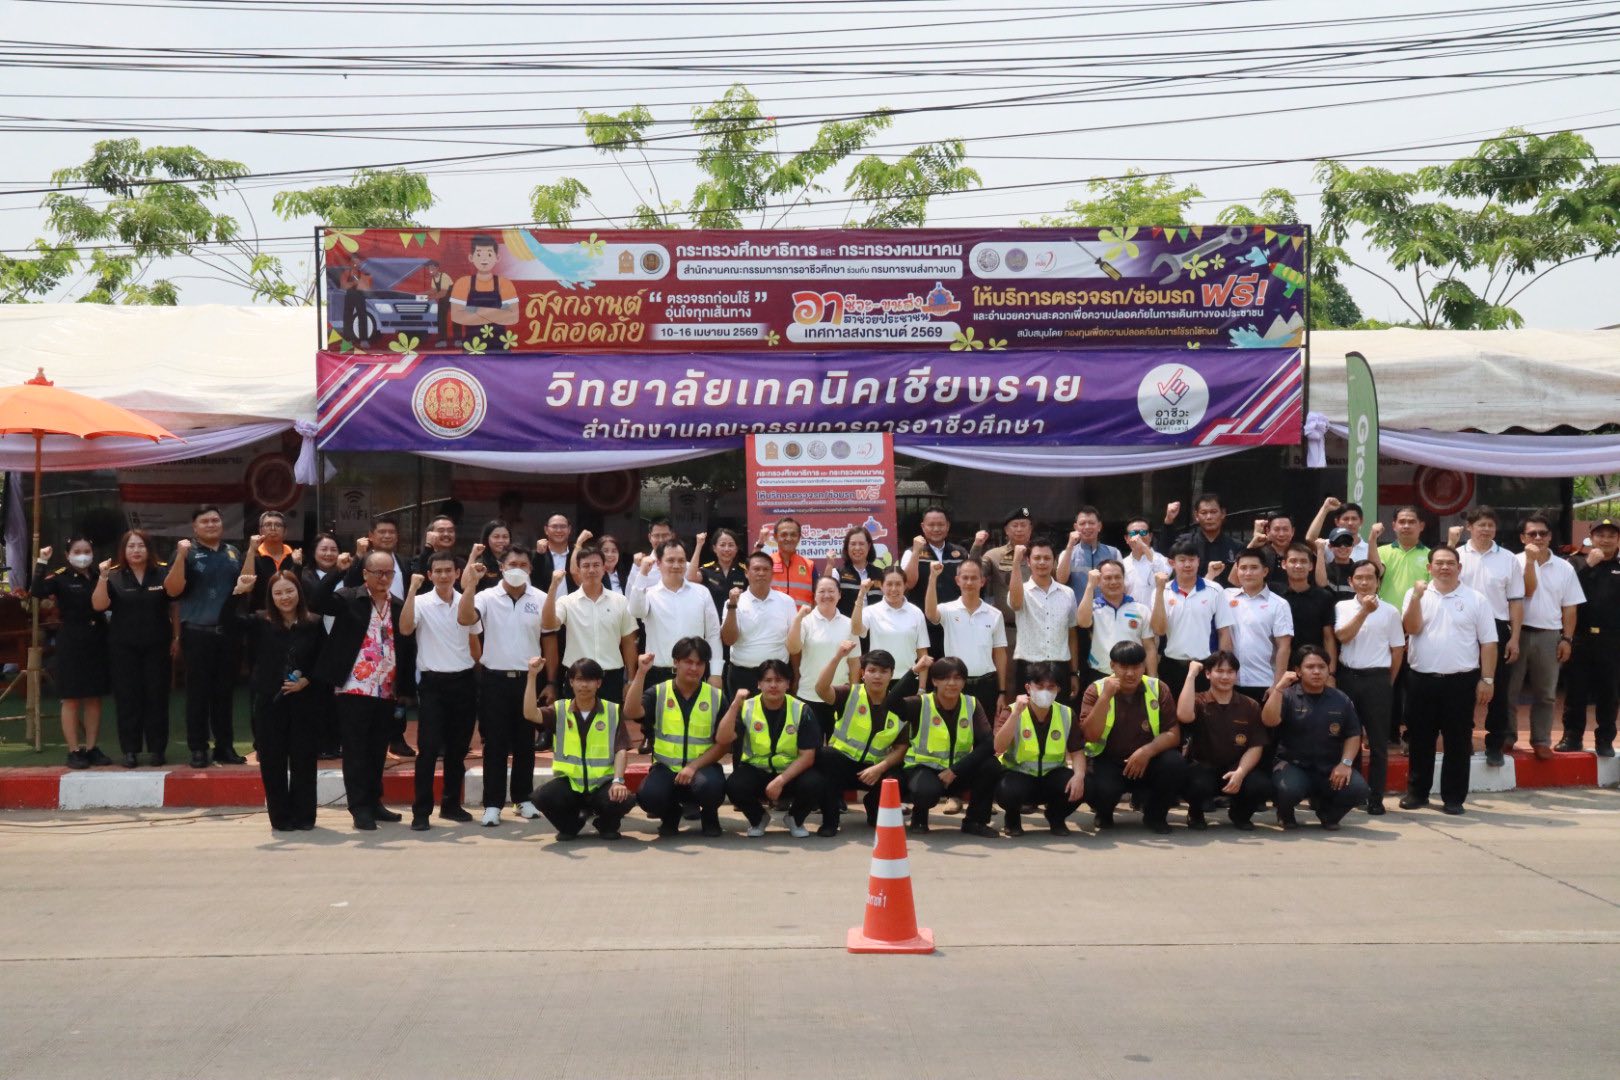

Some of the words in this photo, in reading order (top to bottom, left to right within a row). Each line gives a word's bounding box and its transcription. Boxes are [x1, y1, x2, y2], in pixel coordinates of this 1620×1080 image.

[676, 242, 818, 258] กระทรวงศึกษาธิการ
[820, 247, 836, 257] และ
[838, 244, 963, 257] กระทรวงคมนาคม
[524, 288, 649, 316] สงกรานต์
[665, 305, 752, 319] อุ่นใจทุกเส้นทาง
[524, 315, 645, 345] ปลอดภัย
[661, 328, 692, 337] 10-16
[693, 328, 731, 337] เมษายน
[733, 327, 758, 337] 2569
[804, 324, 908, 339] เทศกาลสงกรานต์
[910, 326, 943, 338] 2569
[545, 365, 1082, 408] วิทยาลัยเทคนิคเชียงราย
[1354, 414, 1369, 507] Gree
